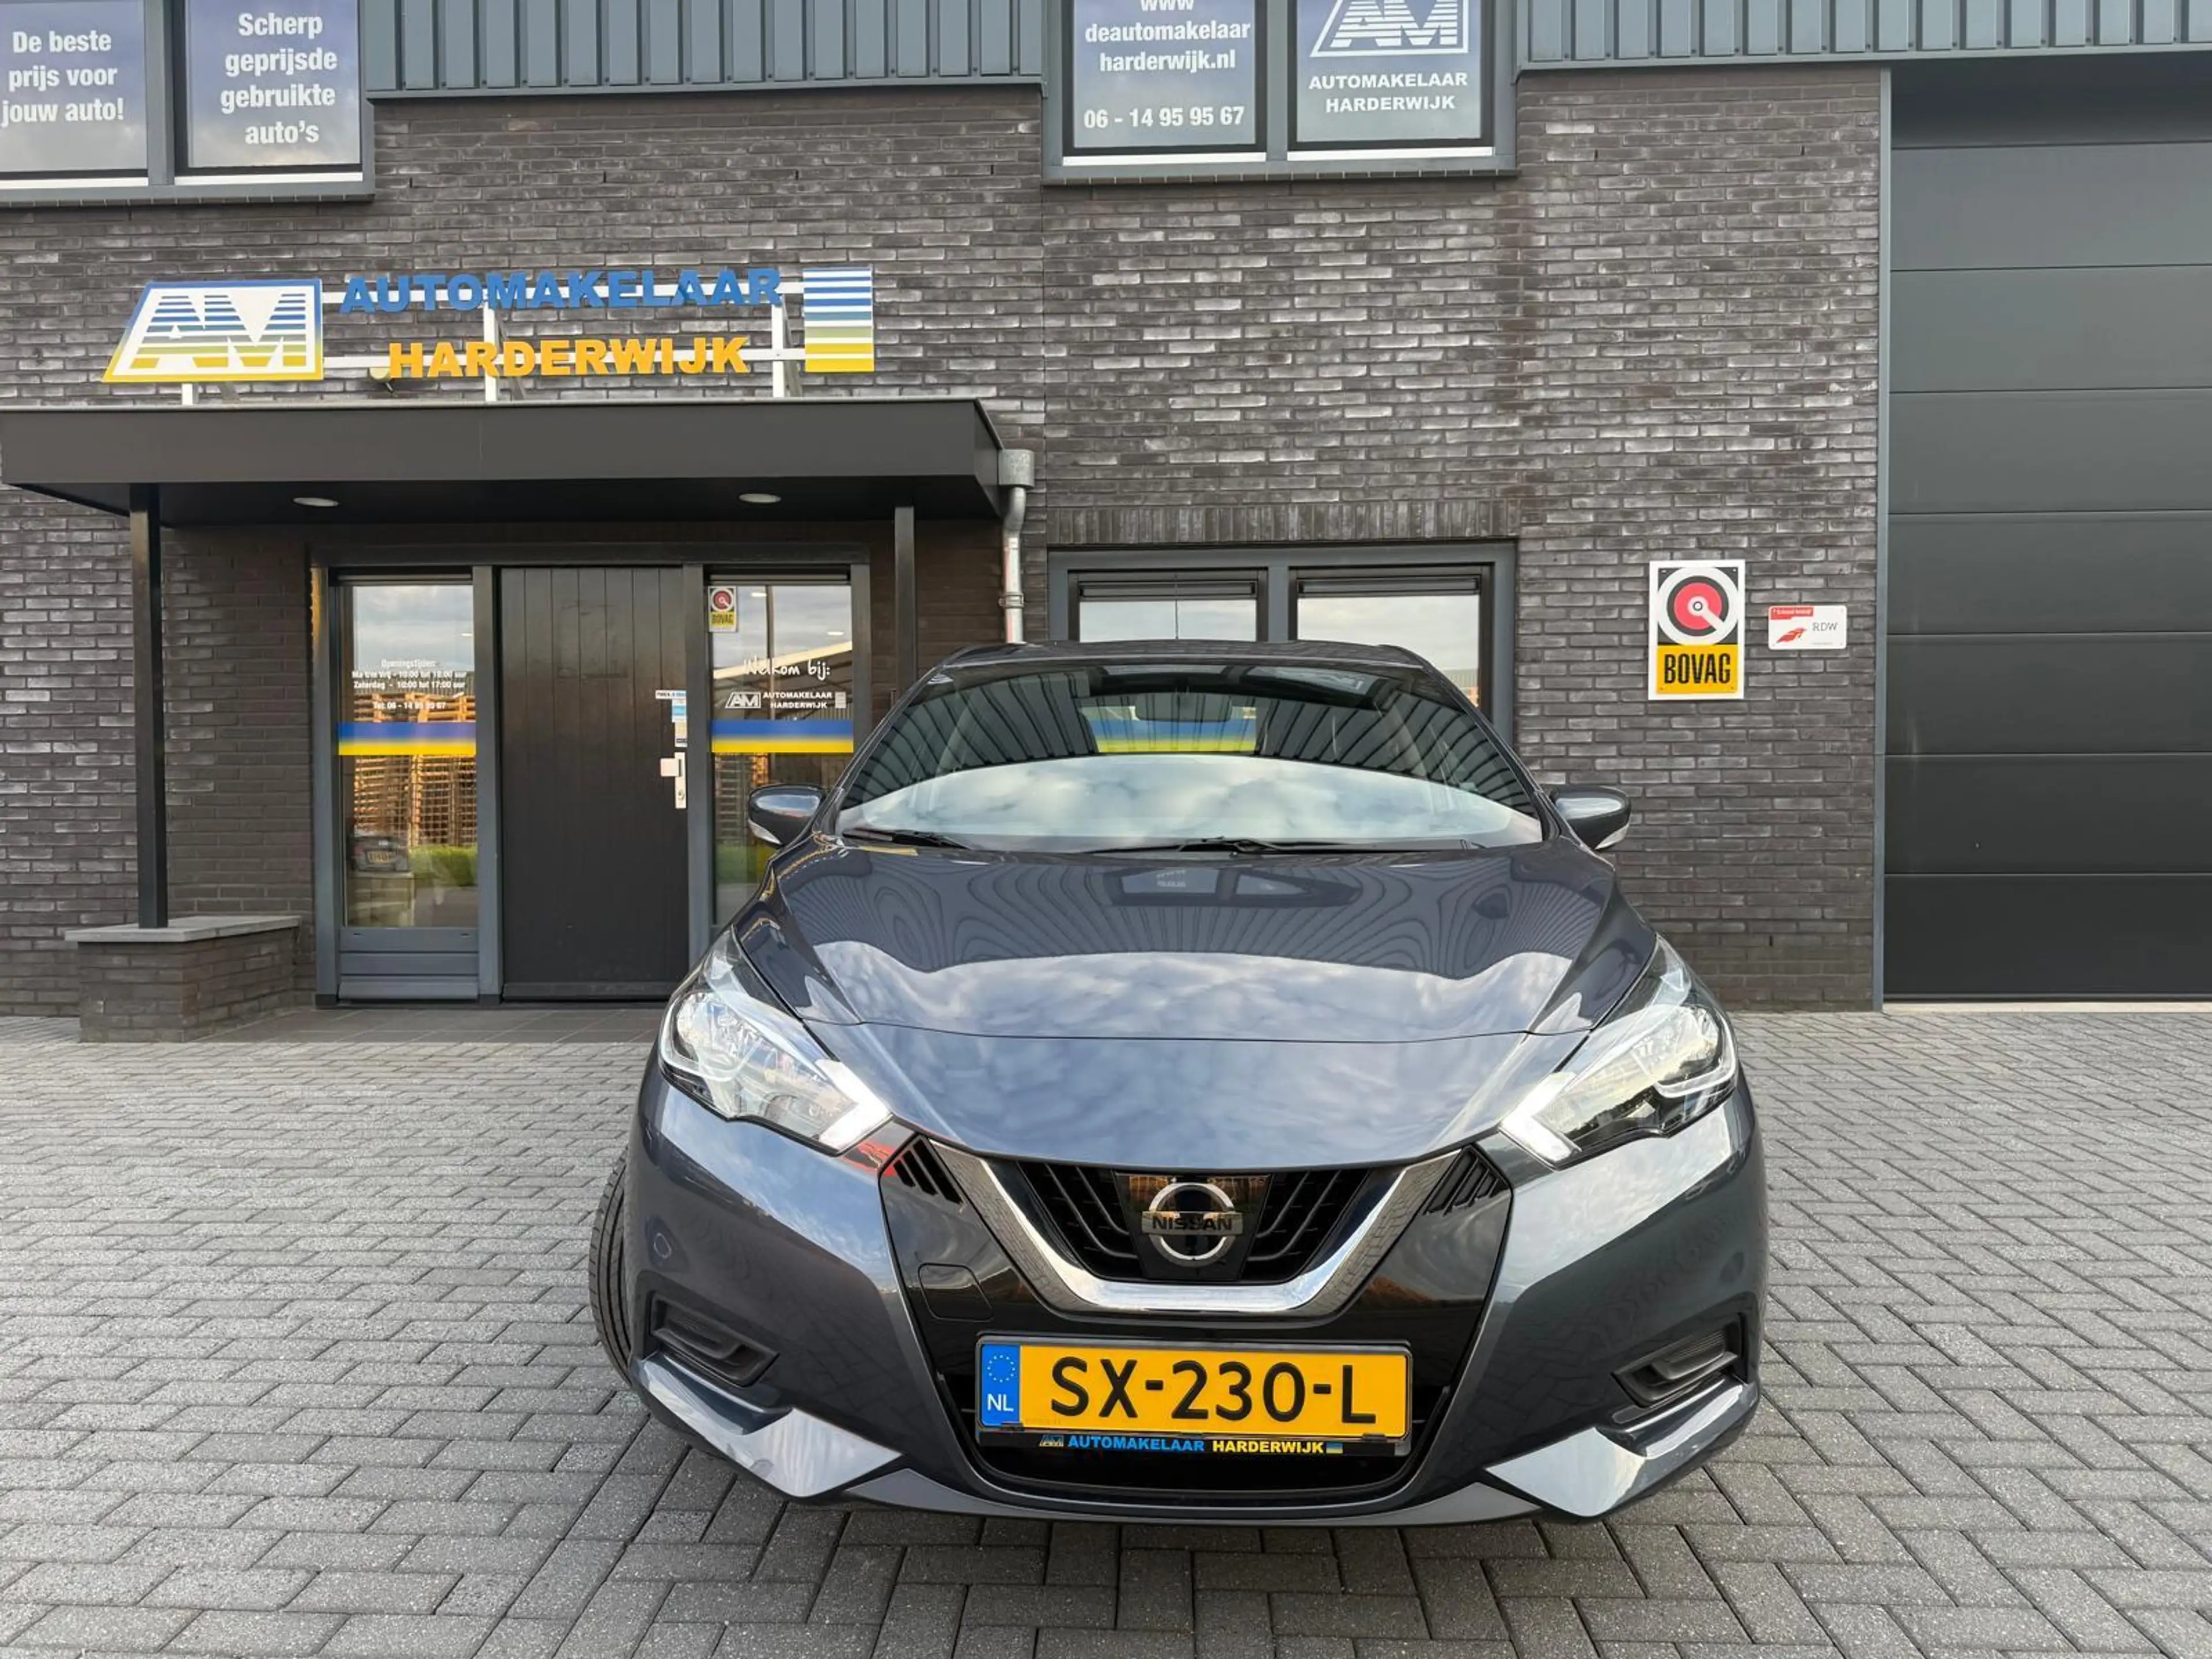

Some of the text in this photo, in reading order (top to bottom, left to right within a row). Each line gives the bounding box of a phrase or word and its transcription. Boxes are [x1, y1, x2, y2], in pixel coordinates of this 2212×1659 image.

[238, 13, 323, 39] Scherp
[1085, 20, 1251, 43] deautomakelaar
[12, 29, 111, 53] De beste
[225, 47, 338, 76] geprijsde
[1100, 50, 1236, 73] harderwijk.nl
[9, 66, 118, 92] prijs voor
[1308, 73, 1468, 89] AUTOMAKELAAR
[221, 84, 336, 114] gebruikte
[1326, 96, 1455, 113] HARDERWIJK
[0, 97, 124, 127] jouw auto!
[1084, 109, 1108, 128] 06
[1130, 108, 1153, 127] 14
[1159, 107, 1183, 126] 95
[1190, 107, 1214, 126] 95
[1220, 106, 1245, 125] 67
[245, 120, 320, 144] auto's
[339, 267, 782, 314] AUTOMAKELAAR
[388, 336, 751, 378] HARDERWIJK
[808, 660, 830, 681] bij:
[1664, 653, 1731, 684] BOVAG
[1153, 1217, 1232, 1230] NISSAN
[987, 1357, 1376, 1424] NL SX-230-L
[1067, 1435, 1204, 1453] AUTOMAKELAAR
[1213, 1440, 1324, 1454] HARDERWIJK
